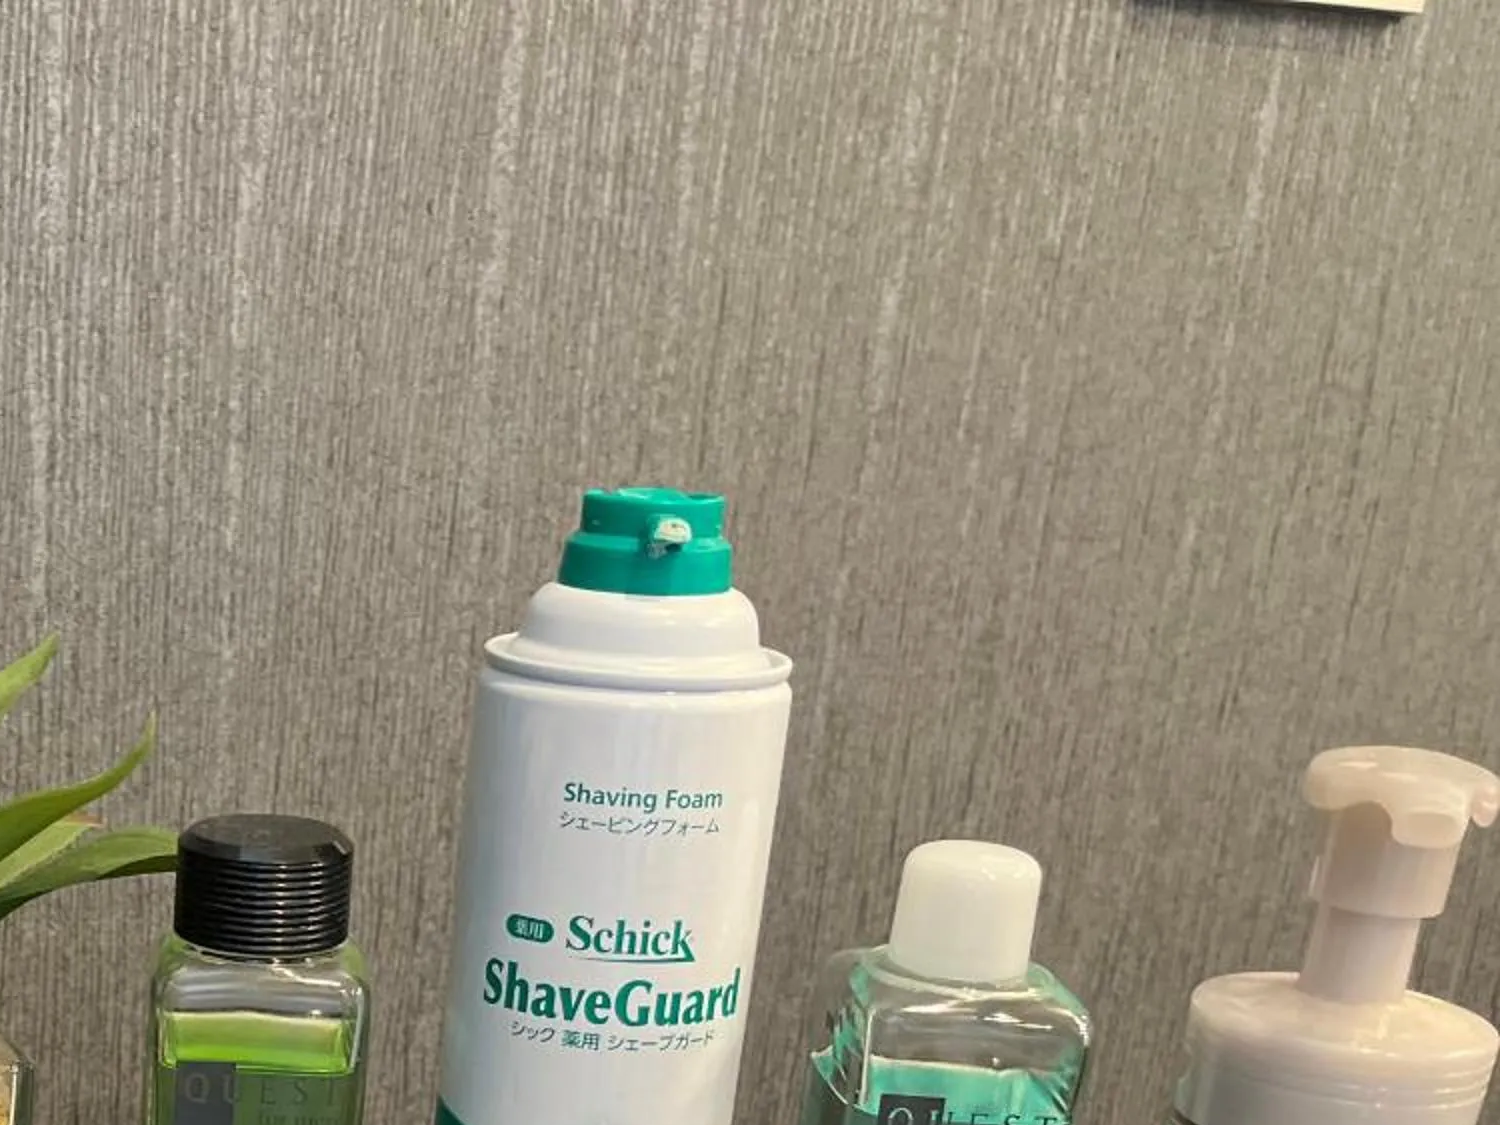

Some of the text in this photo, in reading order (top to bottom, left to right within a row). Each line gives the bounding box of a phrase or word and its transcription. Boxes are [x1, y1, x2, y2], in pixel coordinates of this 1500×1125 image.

[563, 782, 723, 814] Shaving Foam
[559, 811, 720, 835] シェービングフォーム
[565, 915, 695, 962] Schick
[483, 957, 741, 1028] ShaveGuard
[511, 1021, 716, 1052] シック 薬用 シェーブガード
[184, 1072, 342, 1106] QUEST
